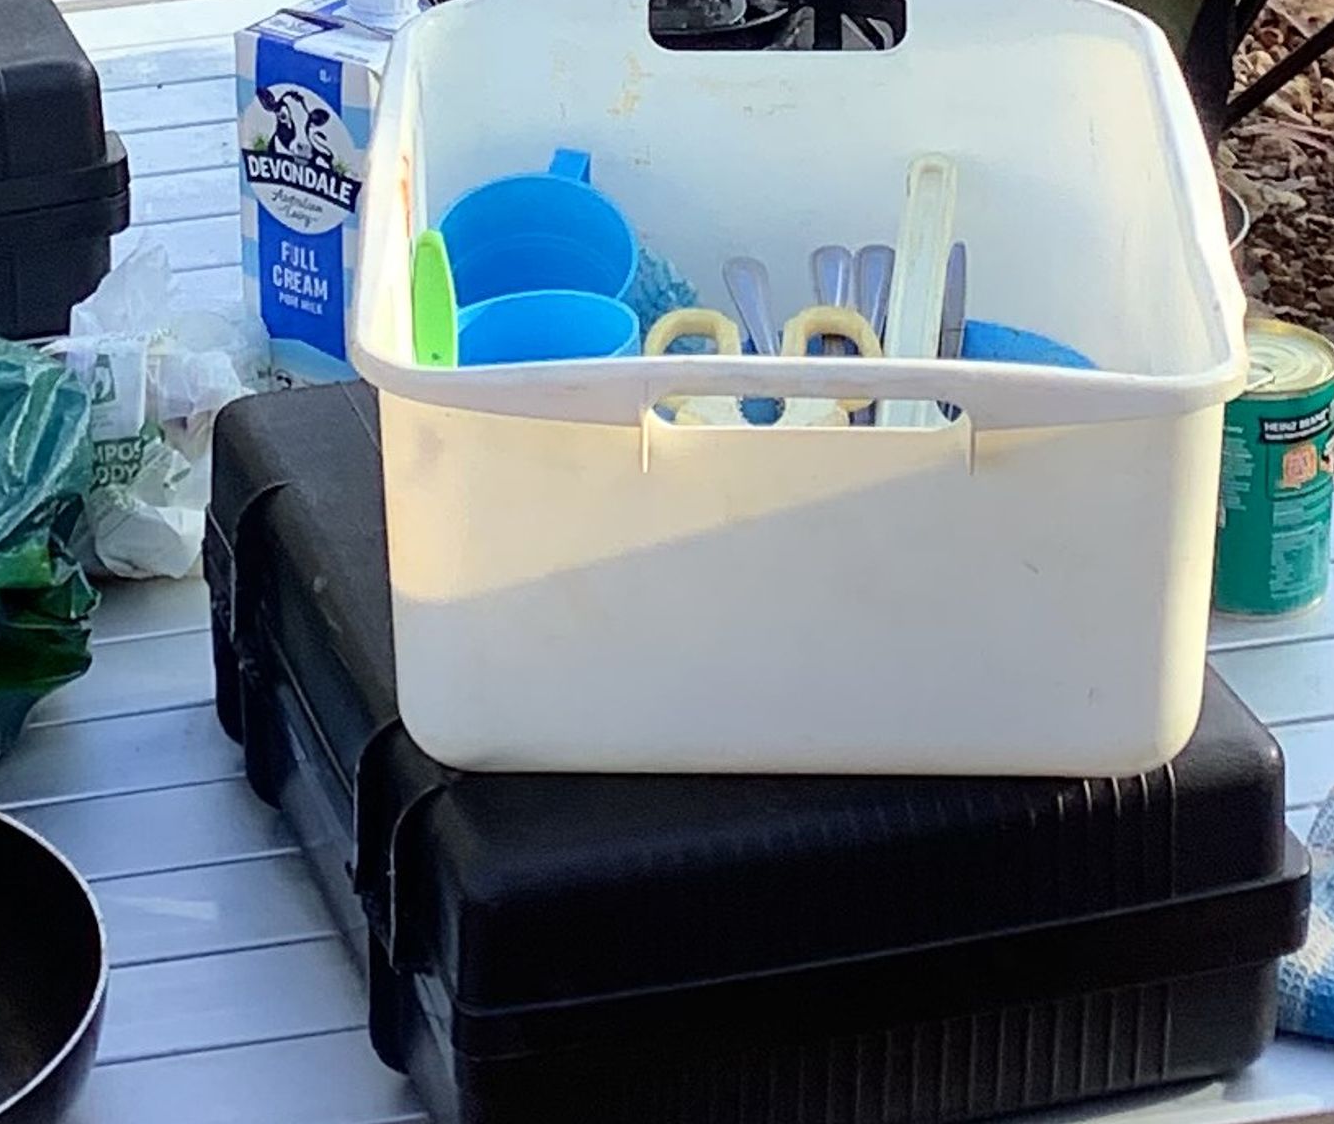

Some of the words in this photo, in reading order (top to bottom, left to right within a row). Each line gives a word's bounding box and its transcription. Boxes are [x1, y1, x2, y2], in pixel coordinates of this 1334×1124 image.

[247, 155, 353, 205] DEVONDALE
[281, 241, 319, 272] FULL
[273, 265, 328, 301] CREAM
